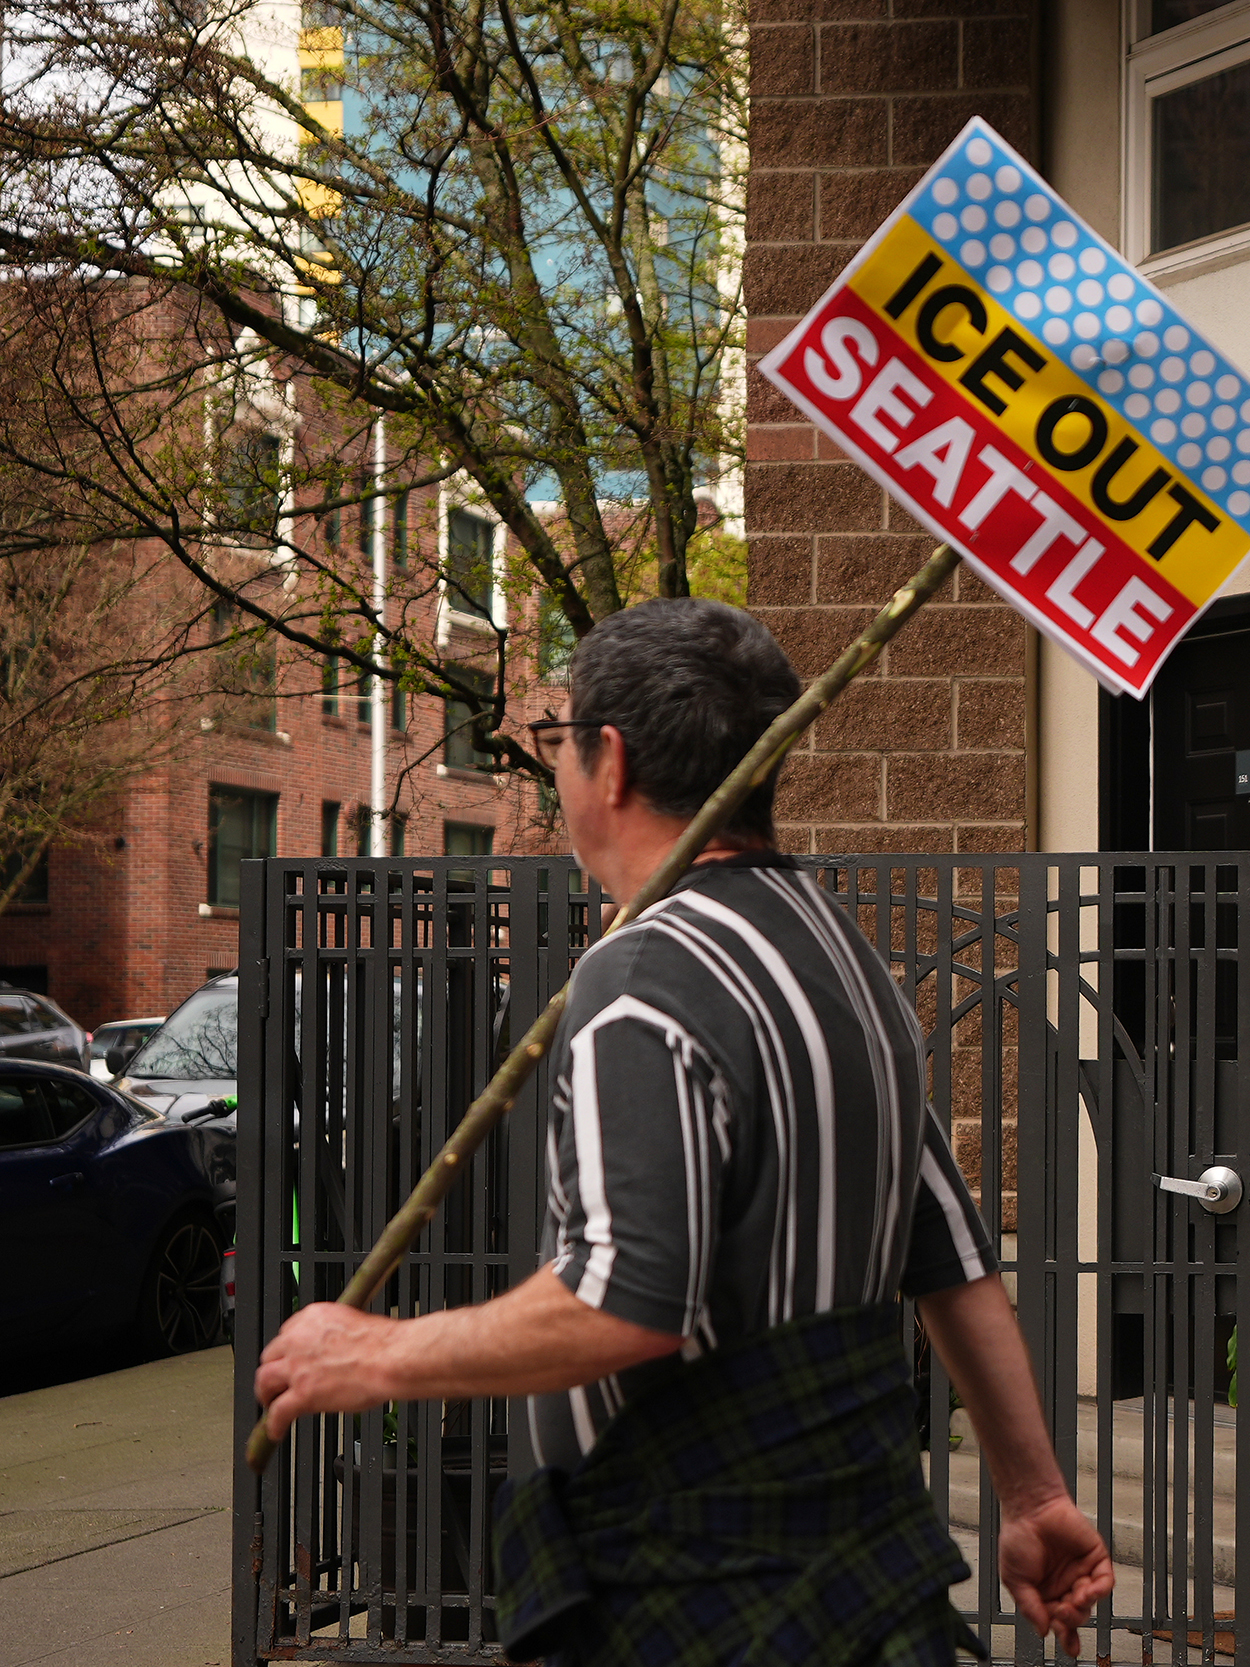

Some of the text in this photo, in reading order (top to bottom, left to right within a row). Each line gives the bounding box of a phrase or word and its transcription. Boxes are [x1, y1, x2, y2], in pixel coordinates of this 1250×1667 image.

[803, 316, 1173, 667] SEATTLE
[884, 251, 1221, 561] ICE OUT
